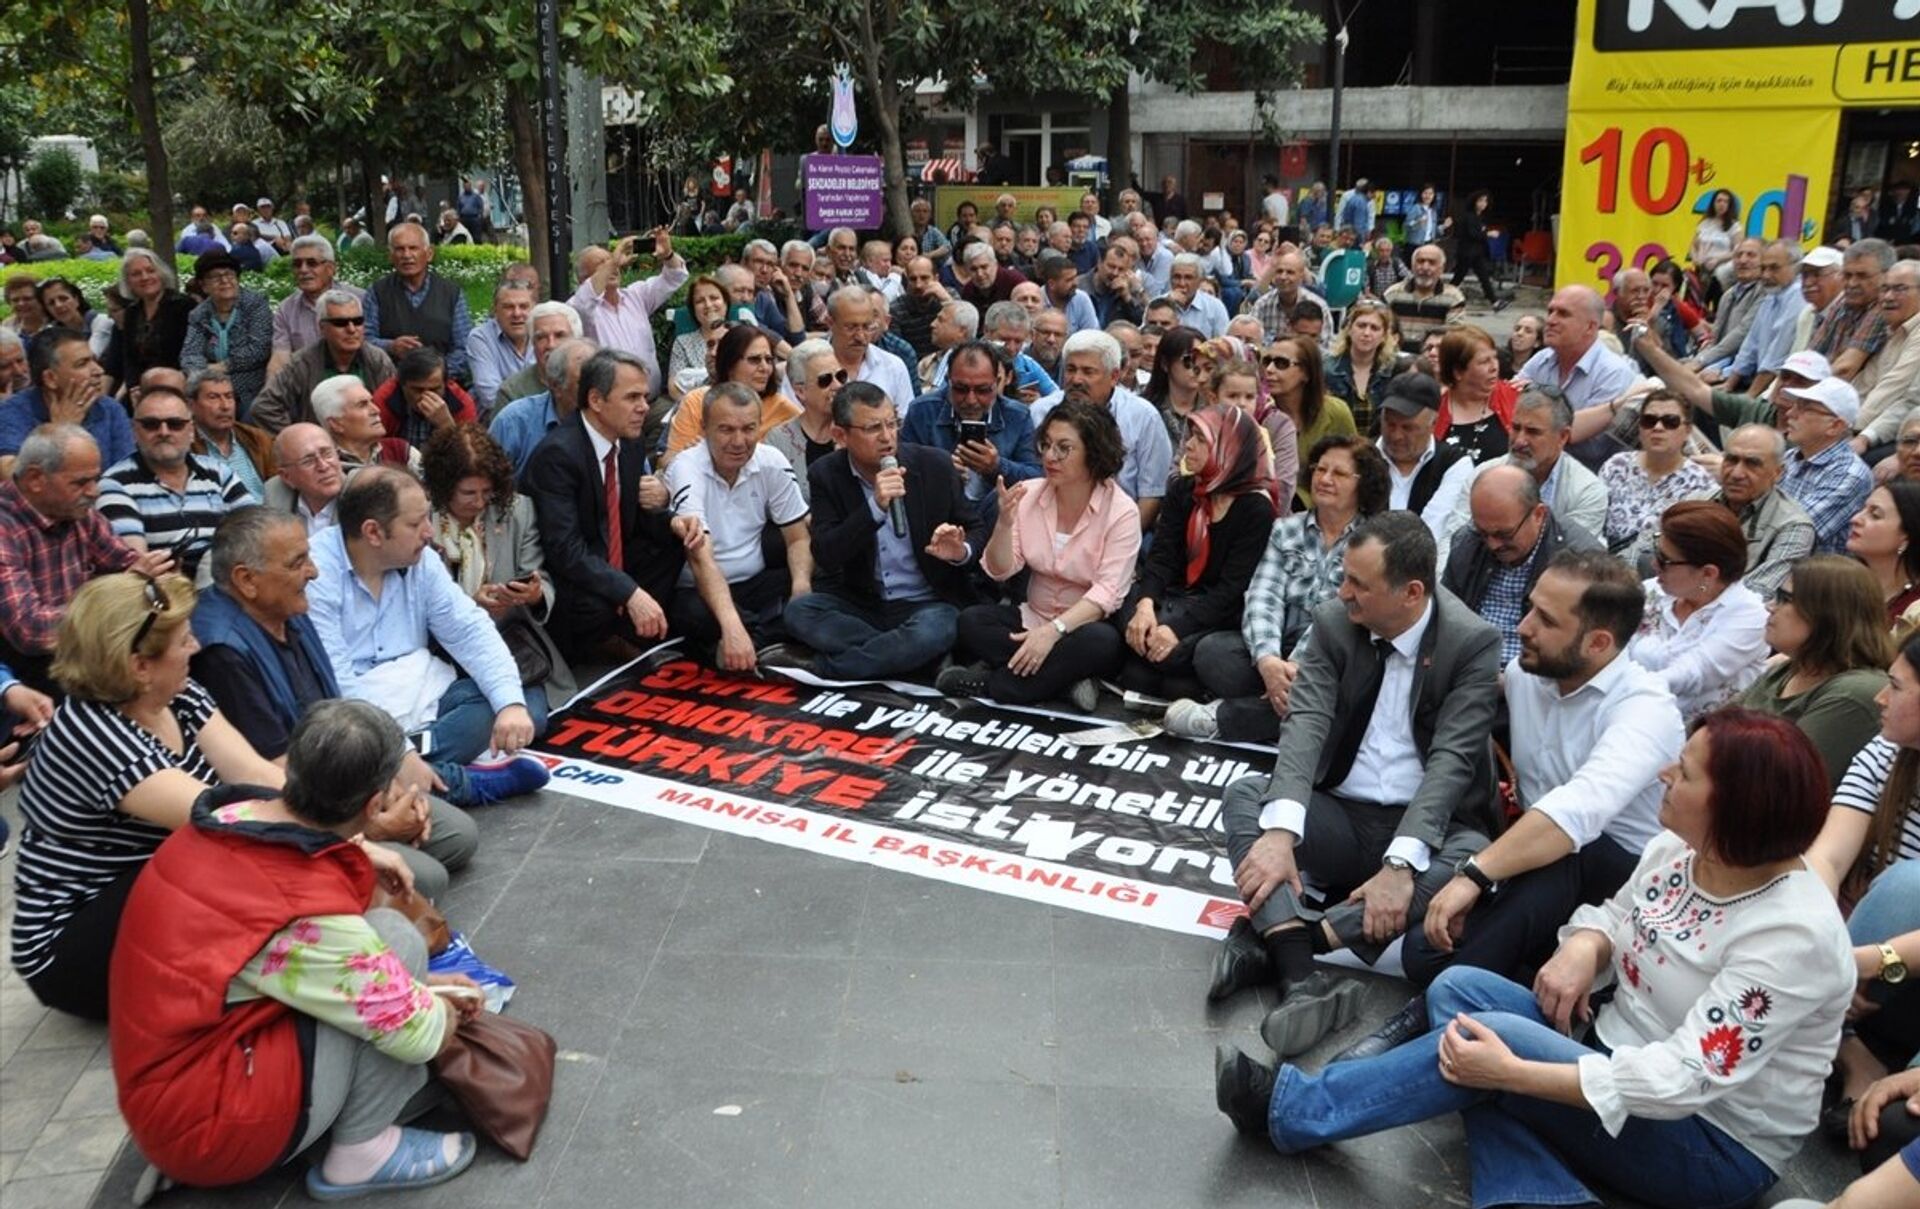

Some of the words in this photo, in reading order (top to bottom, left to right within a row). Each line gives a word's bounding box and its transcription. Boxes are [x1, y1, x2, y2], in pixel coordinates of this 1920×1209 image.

[548, 718, 887, 811] TÜRKİYE
[552, 765, 625, 785] CHP
[592, 689, 918, 768] DEMOKRASİ
[910, 749, 988, 783] ile
[799, 690, 862, 718] ile
[855, 702, 1080, 760] yönetilen
[1089, 742, 1171, 773] bir
[1181, 754, 1272, 790] ülk
[657, 788, 808, 833] MANİSA
[821, 822, 859, 845] İL
[872, 836, 1159, 908] BAŞKANLIĞI
